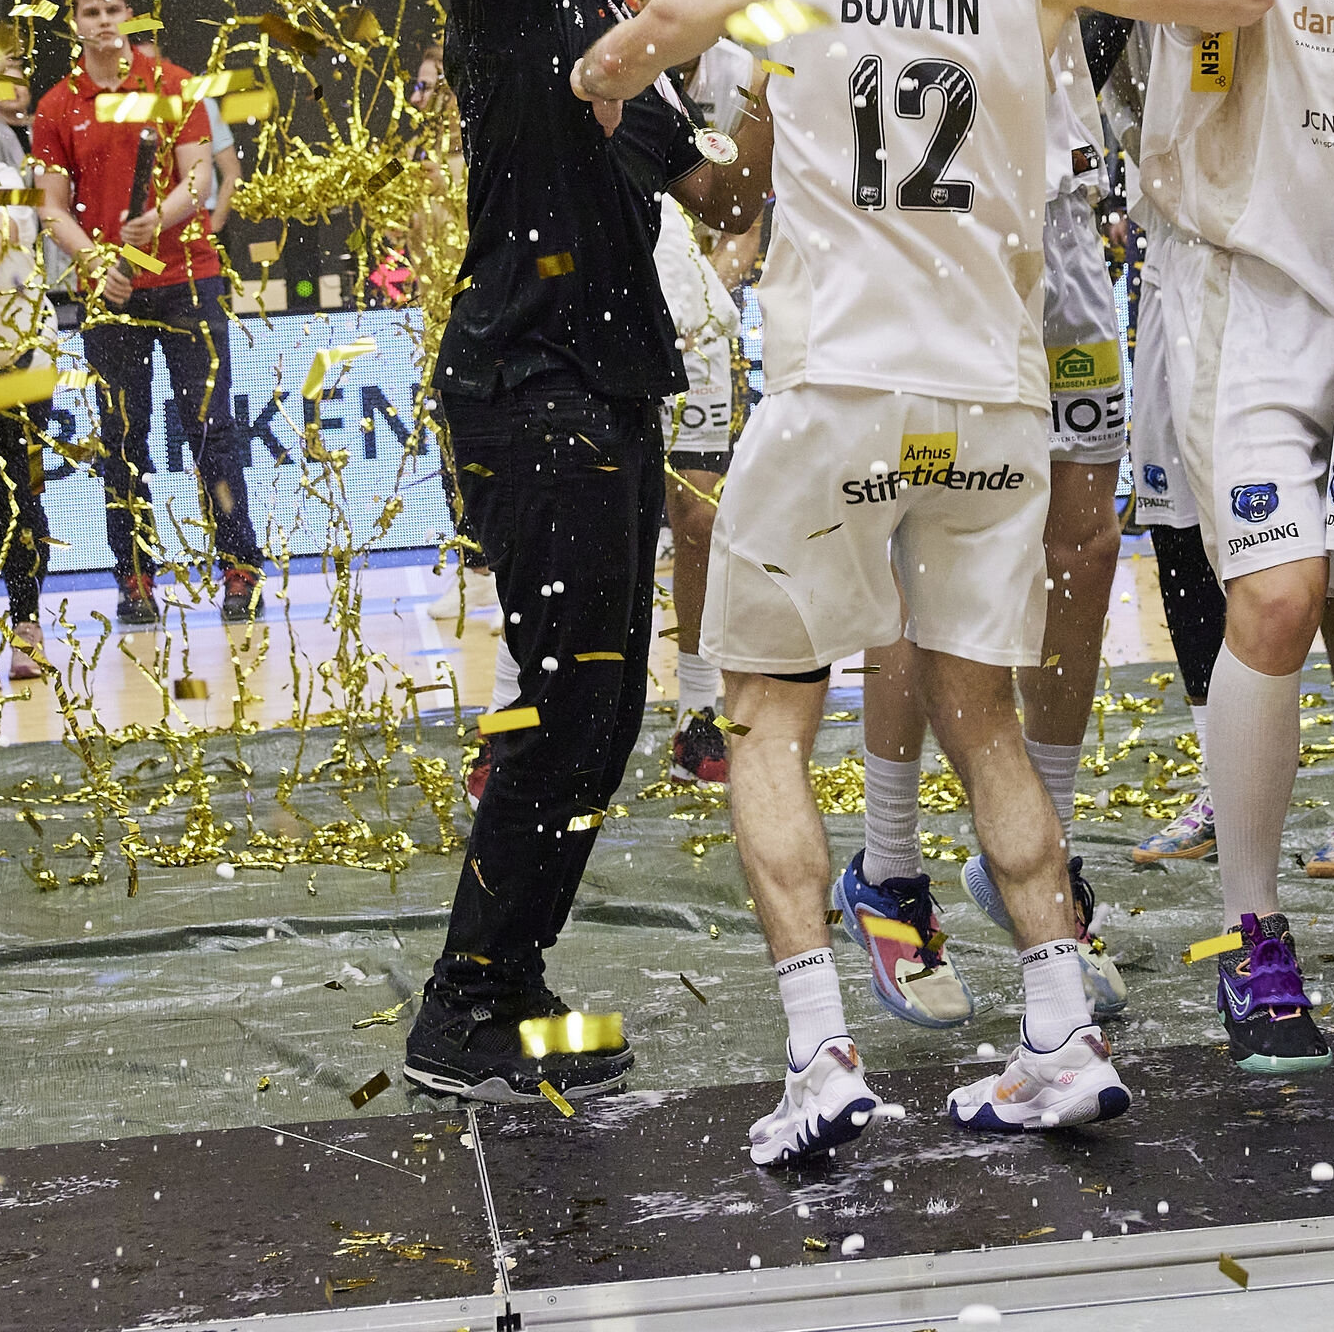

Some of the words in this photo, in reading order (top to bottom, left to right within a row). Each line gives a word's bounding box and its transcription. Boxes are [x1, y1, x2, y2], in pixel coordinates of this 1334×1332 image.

[1201, 32, 1220, 75] SEN
[848, 54, 979, 213] 12
[904, 444, 951, 461] Århus
[1228, 522, 1300, 556] SPALDING
